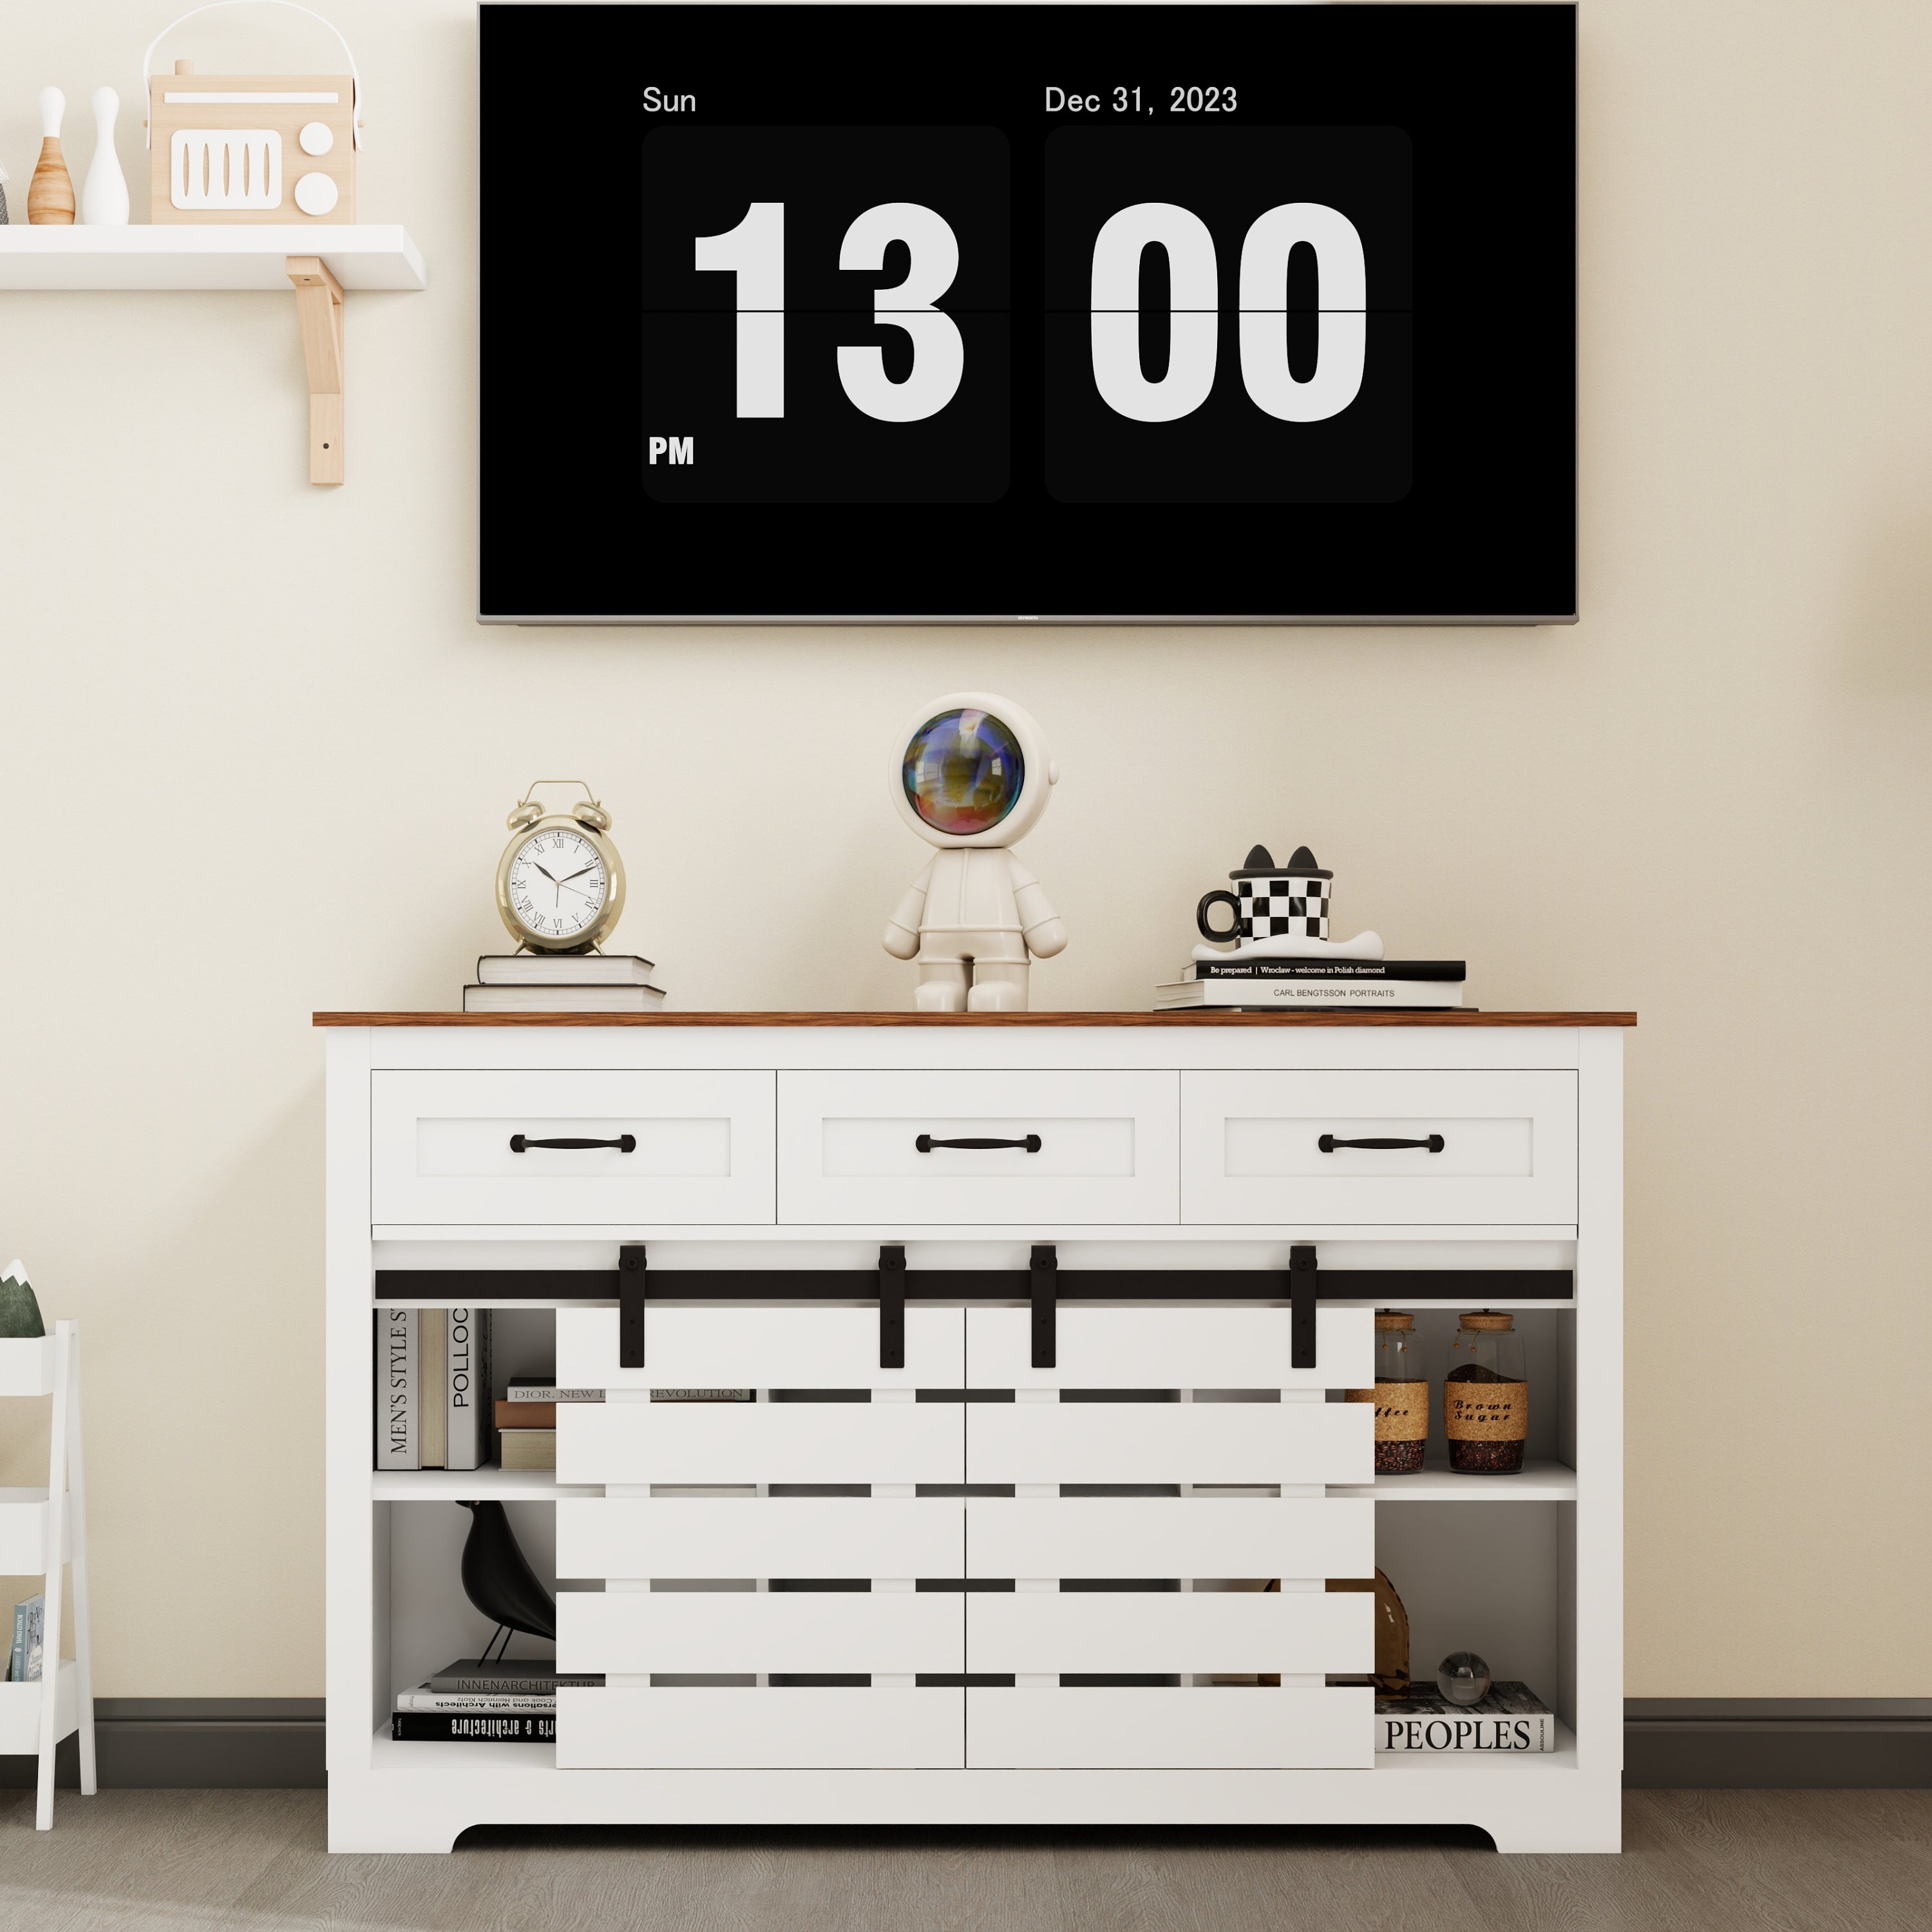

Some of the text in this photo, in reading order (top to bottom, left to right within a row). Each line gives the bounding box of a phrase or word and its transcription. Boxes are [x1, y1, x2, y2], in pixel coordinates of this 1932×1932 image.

[643, 86, 696, 112] Sun
[1046, 86, 1237, 116] Dec 31, 2023
[695, 202, 964, 422] 13
[1090, 202, 1367, 422] 00
[649, 437, 694, 465] PM
[534, 844, 545, 855] XI
[553, 839, 564, 848] XII
[522, 859, 532, 868] X
[521, 895, 534, 913] VIII
[533, 912, 546, 925] VII
[553, 919, 562, 929] VI
[1220, 967, 1253, 975] prepared
[1350, 989, 1395, 998] PORTRAITS
[390, 1309, 407, 1454] MEN'S STYLE S
[515, 1390, 554, 1398] DIOR.
[560, 1390, 594, 1398] NEW
[1454, 1399, 1511, 1410] Brown
[1375, 1407, 1408, 1417] ffee
[1454, 1410, 1510, 1423] Sugar
[457, 1680, 595, 1690] INNENARCHITEKTUR
[451, 1719, 519, 1738] architecture
[538, 1719, 556, 1738] rts
[1385, 1720, 1530, 1750] PEOPLES
